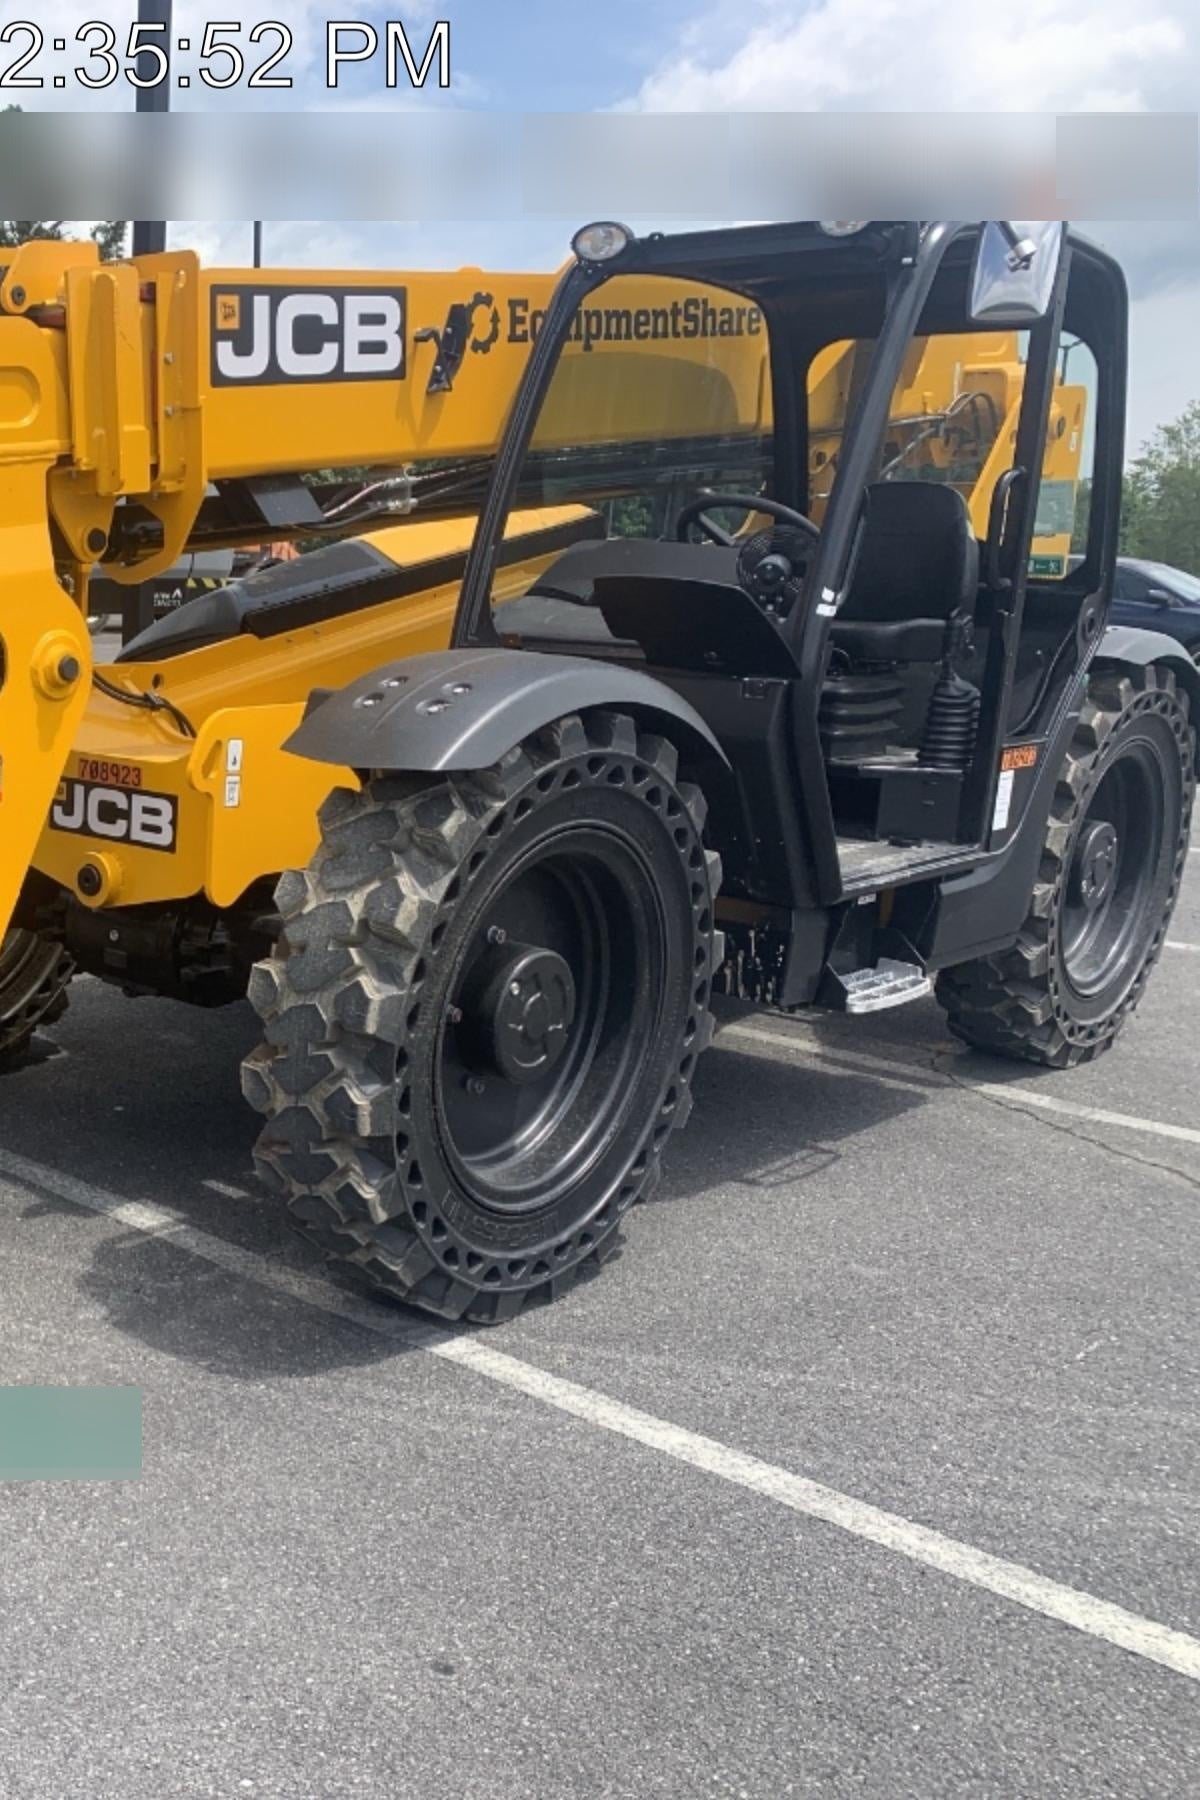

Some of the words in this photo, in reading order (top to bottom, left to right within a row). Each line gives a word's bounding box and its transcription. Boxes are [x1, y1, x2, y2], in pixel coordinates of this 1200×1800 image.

[216, 293, 403, 379] JCB
[78, 759, 142, 787] 708923
[53, 783, 174, 847] JCB
